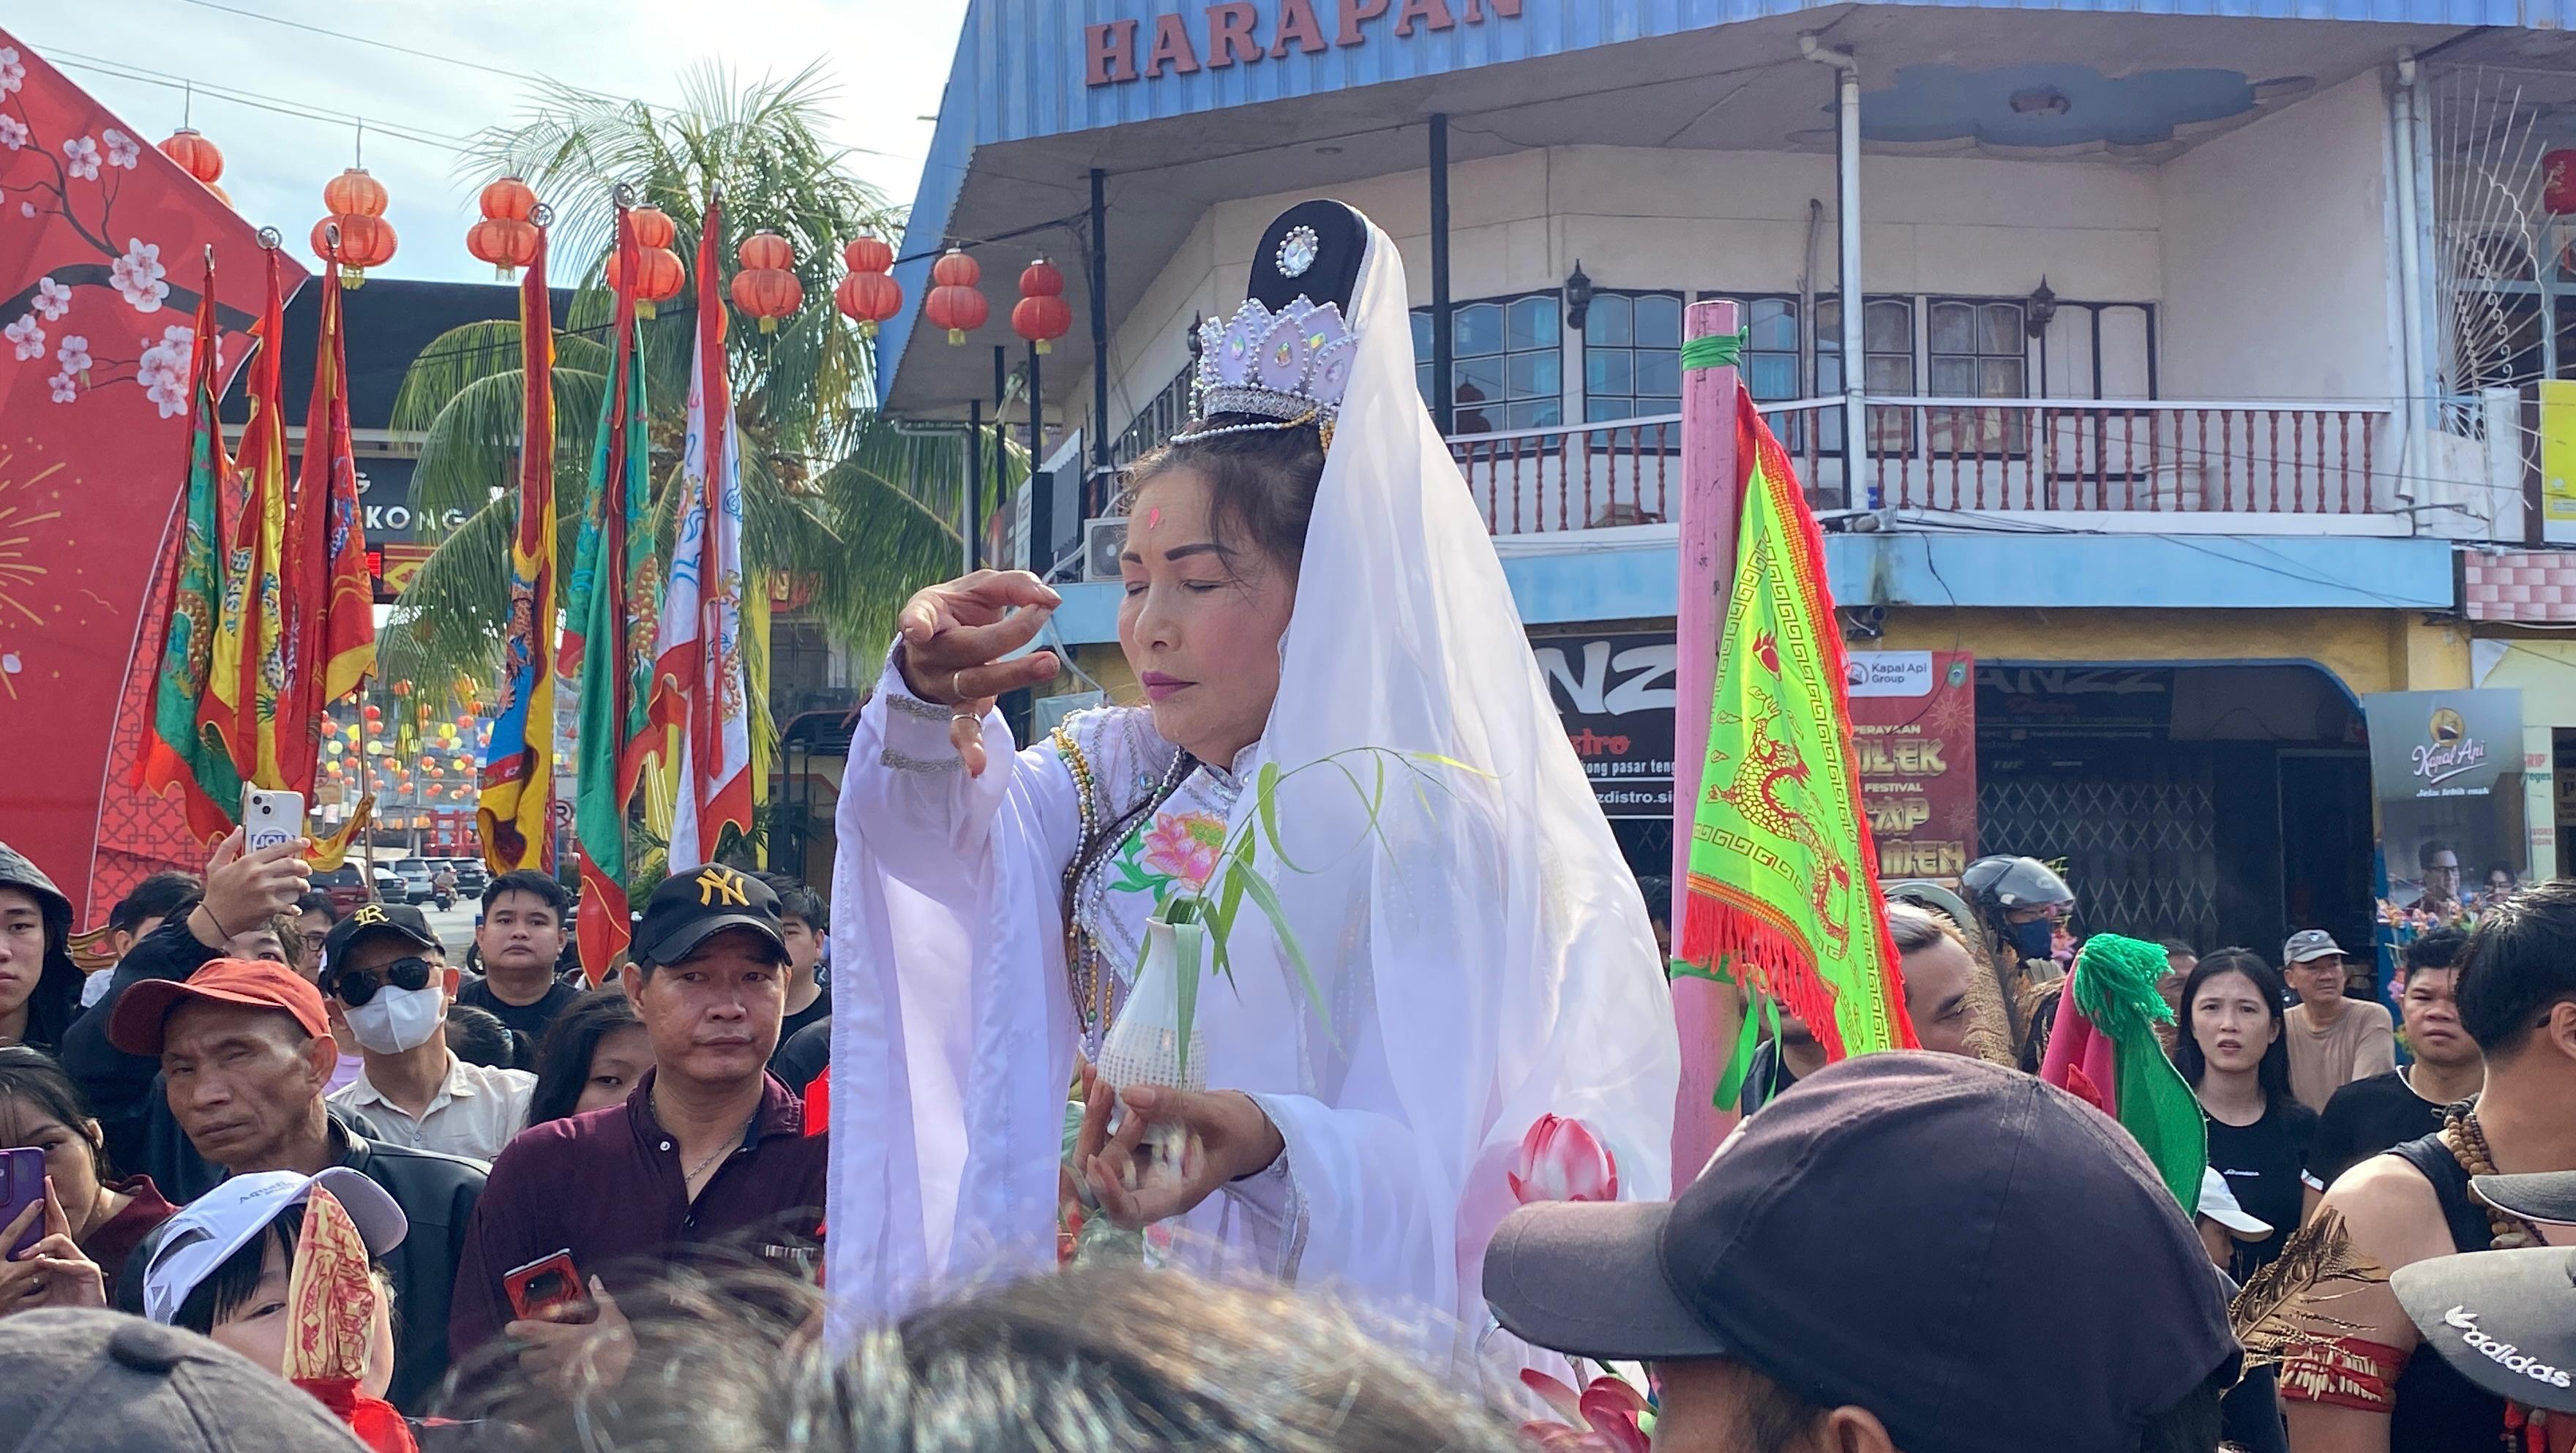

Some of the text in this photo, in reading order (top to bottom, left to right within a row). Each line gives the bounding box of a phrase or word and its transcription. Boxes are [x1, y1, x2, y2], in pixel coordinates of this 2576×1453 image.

[1871, 663, 1904, 674] Kapal
[1871, 675, 1905, 684] Group
[1854, 725, 1921, 735] PERAYAAN
[2412, 738, 2487, 778] Kapal Api
[1611, 761, 1647, 777] pasar
[1864, 782, 1924, 792] FESTIVAL
[2463, 1331, 2571, 1387] adidas
